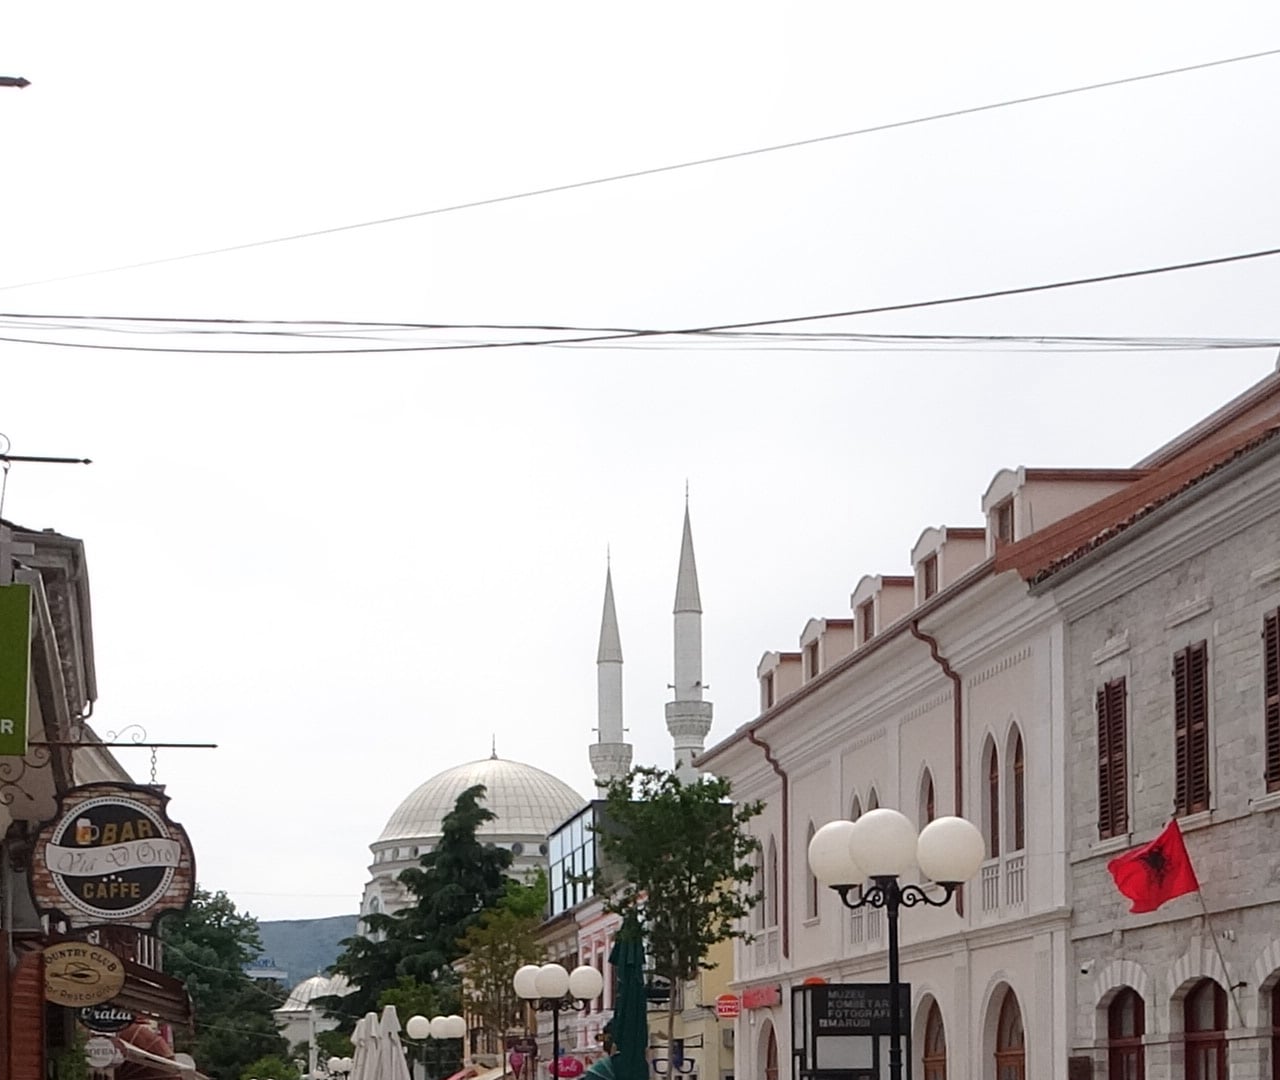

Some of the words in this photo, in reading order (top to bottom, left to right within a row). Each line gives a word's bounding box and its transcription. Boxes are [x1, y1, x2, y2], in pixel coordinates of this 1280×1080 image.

[102, 820, 154, 845] BAR
[83, 883, 140, 898] CAFFE
[90, 952, 117, 972] CLUB
